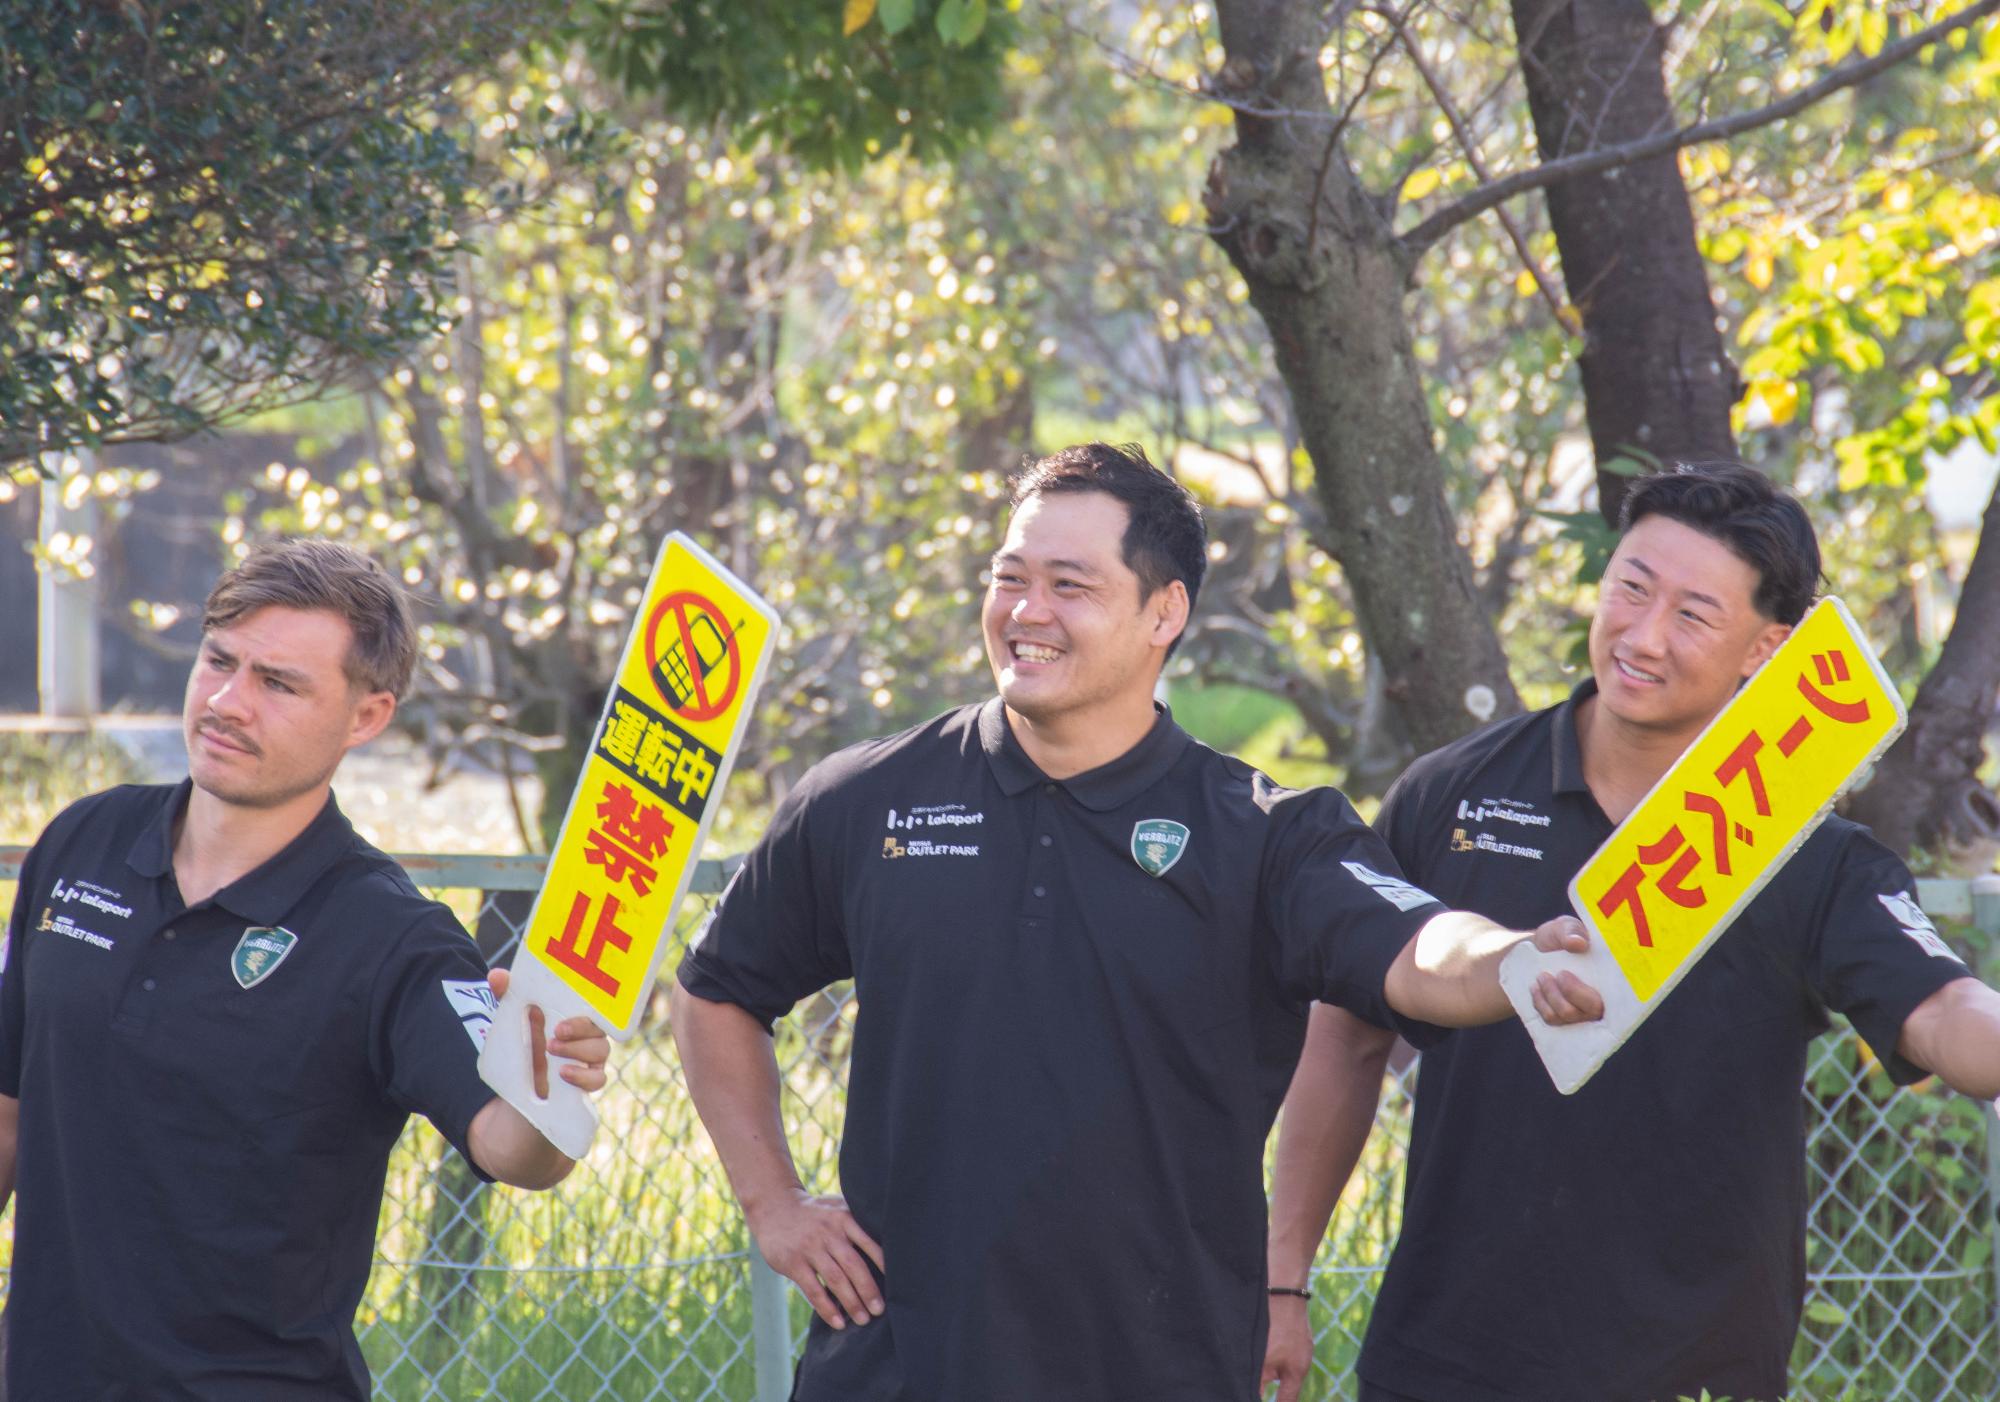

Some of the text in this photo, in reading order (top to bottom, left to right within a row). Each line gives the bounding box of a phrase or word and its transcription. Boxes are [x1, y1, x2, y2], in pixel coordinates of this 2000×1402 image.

[600, 700, 715, 805] 運転中
[1598, 650, 1870, 948] シートベルト
[906, 845, 979, 857] OUTLET PARK
[1512, 845, 1543, 860] PARK
[545, 781, 674, 998] 禁止
[51, 921, 114, 951] OUTLET PARK
